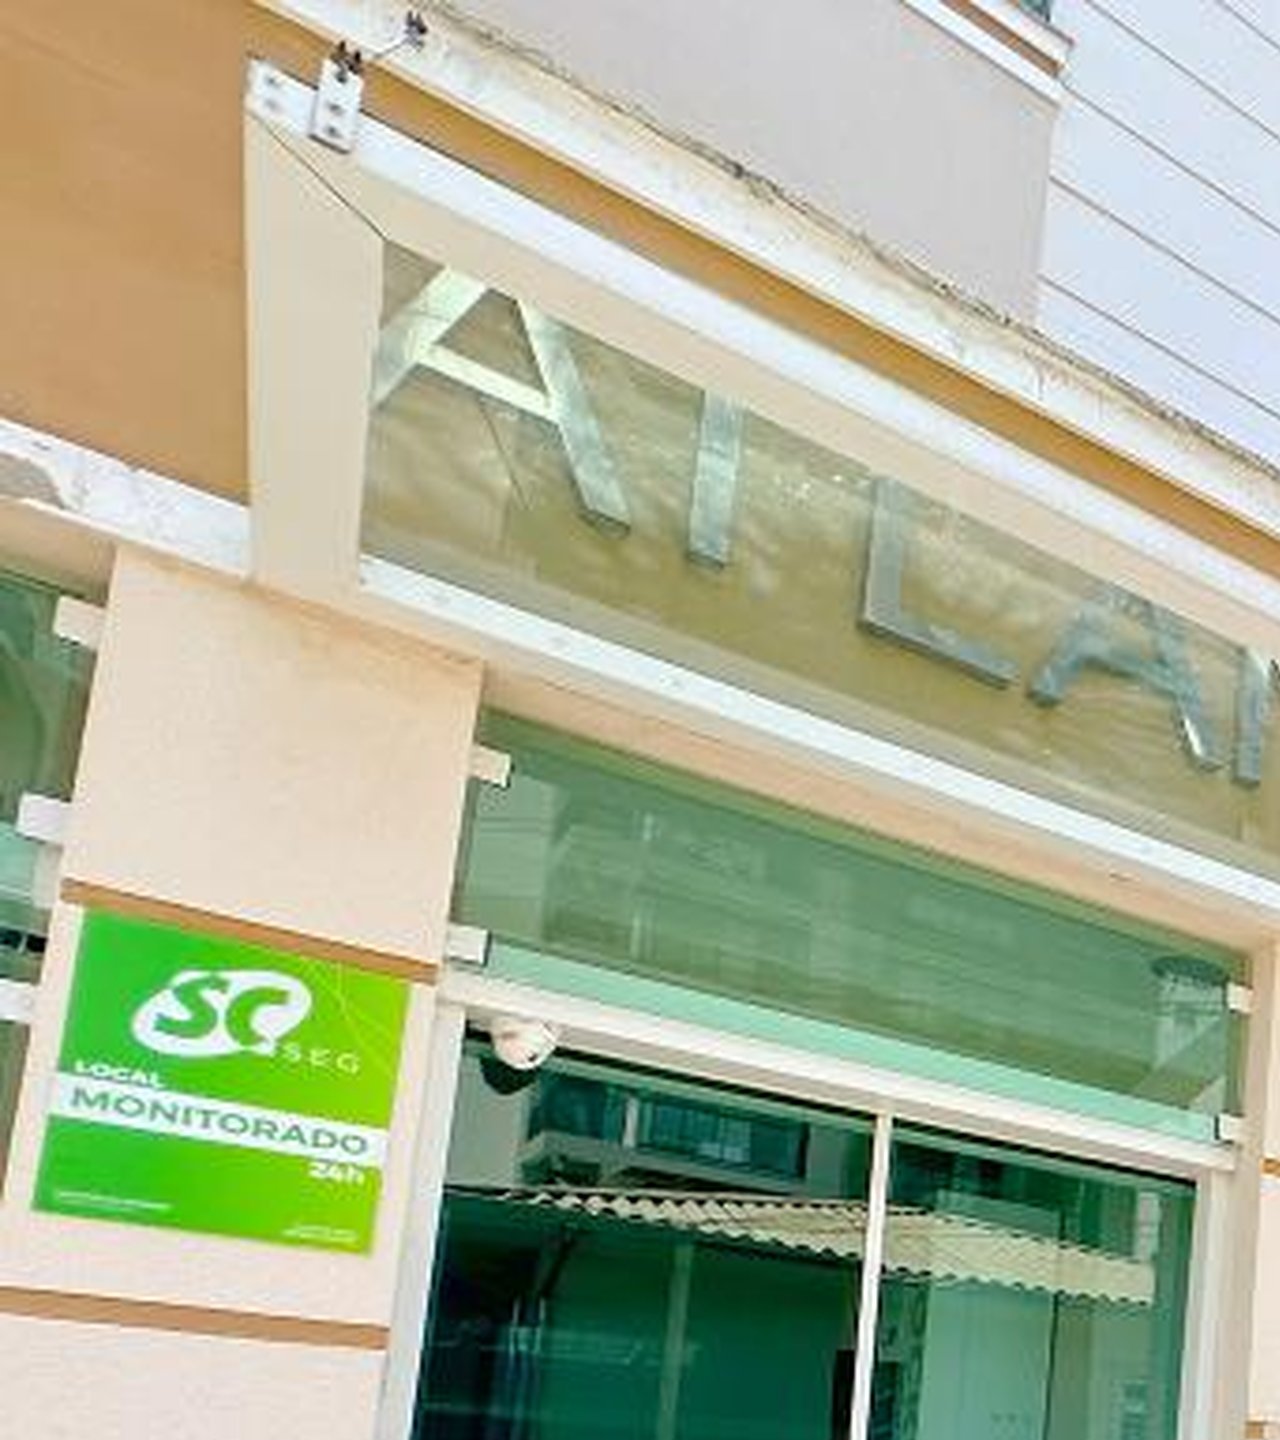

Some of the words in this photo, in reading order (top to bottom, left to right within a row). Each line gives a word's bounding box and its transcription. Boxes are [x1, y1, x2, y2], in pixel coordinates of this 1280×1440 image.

[75, 1058, 164, 1087] LOCAL
[283, 1042, 361, 1075] SEG
[70, 1086, 368, 1156] MONITORADO
